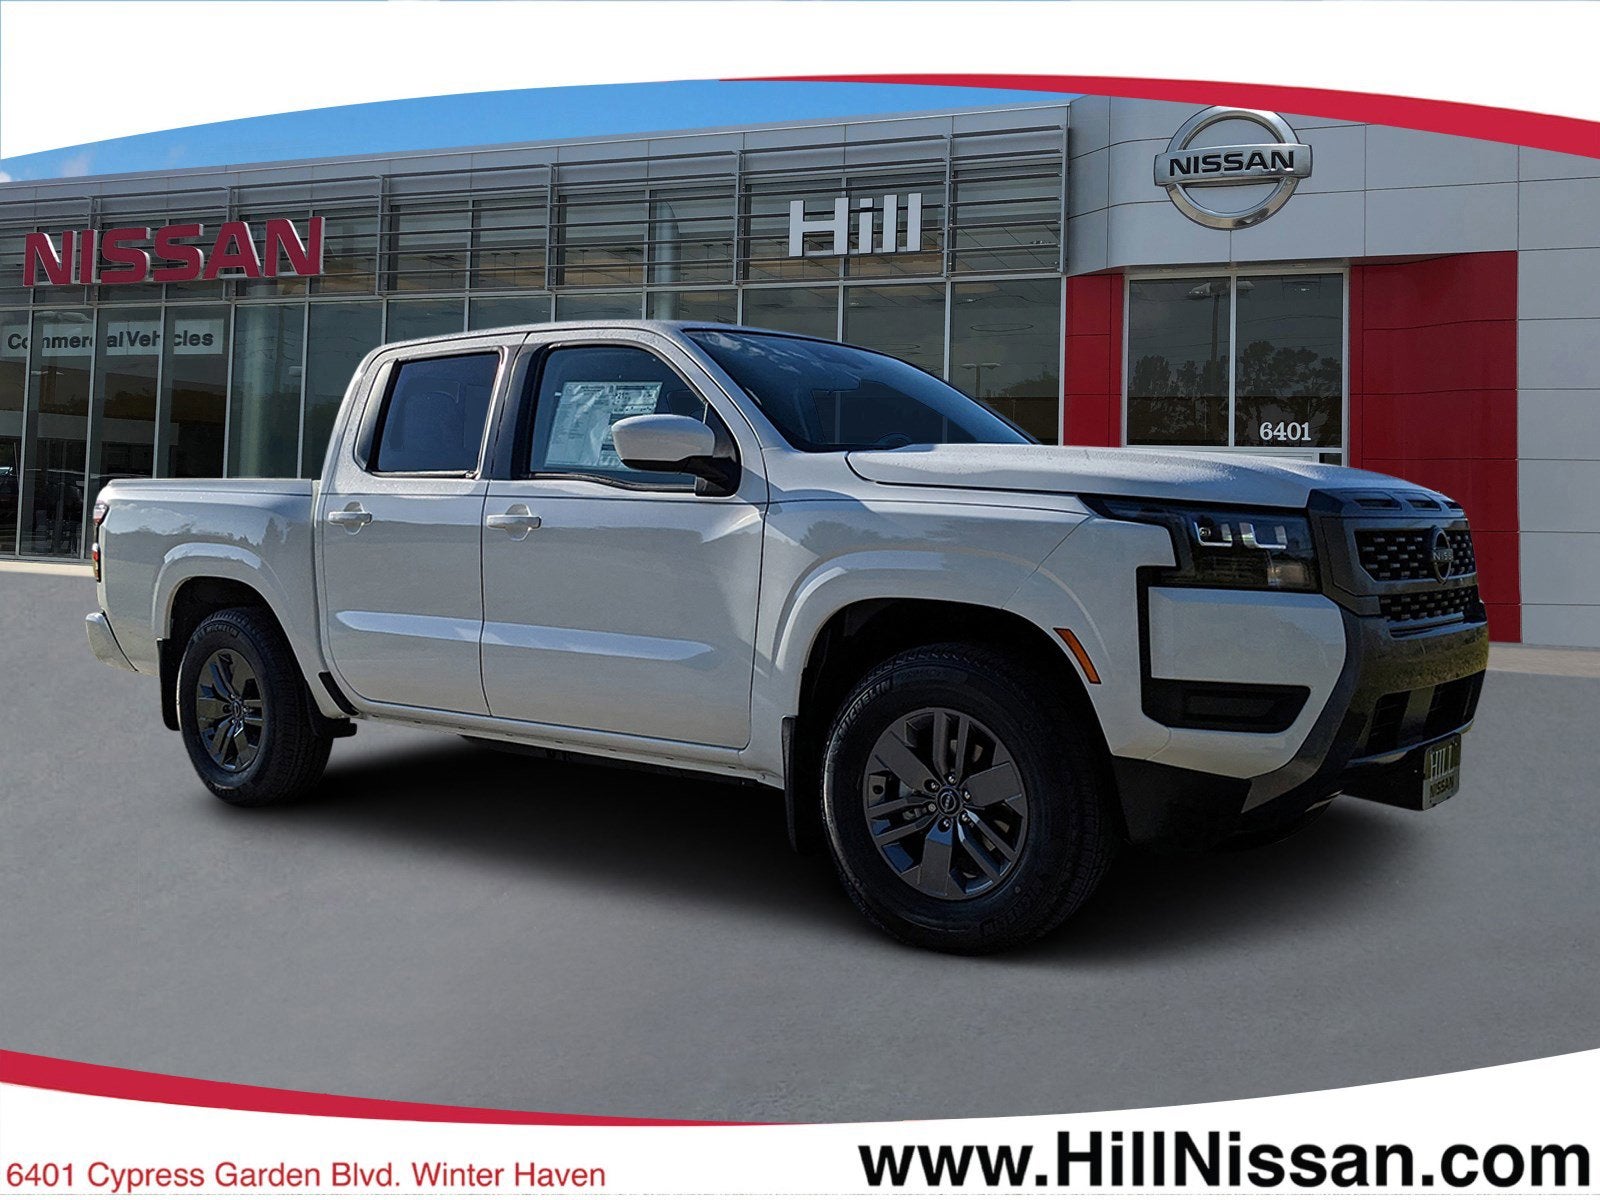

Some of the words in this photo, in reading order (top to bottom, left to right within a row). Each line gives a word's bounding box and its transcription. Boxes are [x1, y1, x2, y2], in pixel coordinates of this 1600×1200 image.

[1169, 150, 1294, 176] NISSAN
[788, 192, 922, 257] Hill
[23, 216, 325, 287] NISSAN
[127, 330, 214, 348] Vehcles
[1260, 422, 1311, 440] 6401
[1430, 745, 1454, 781] HILL
